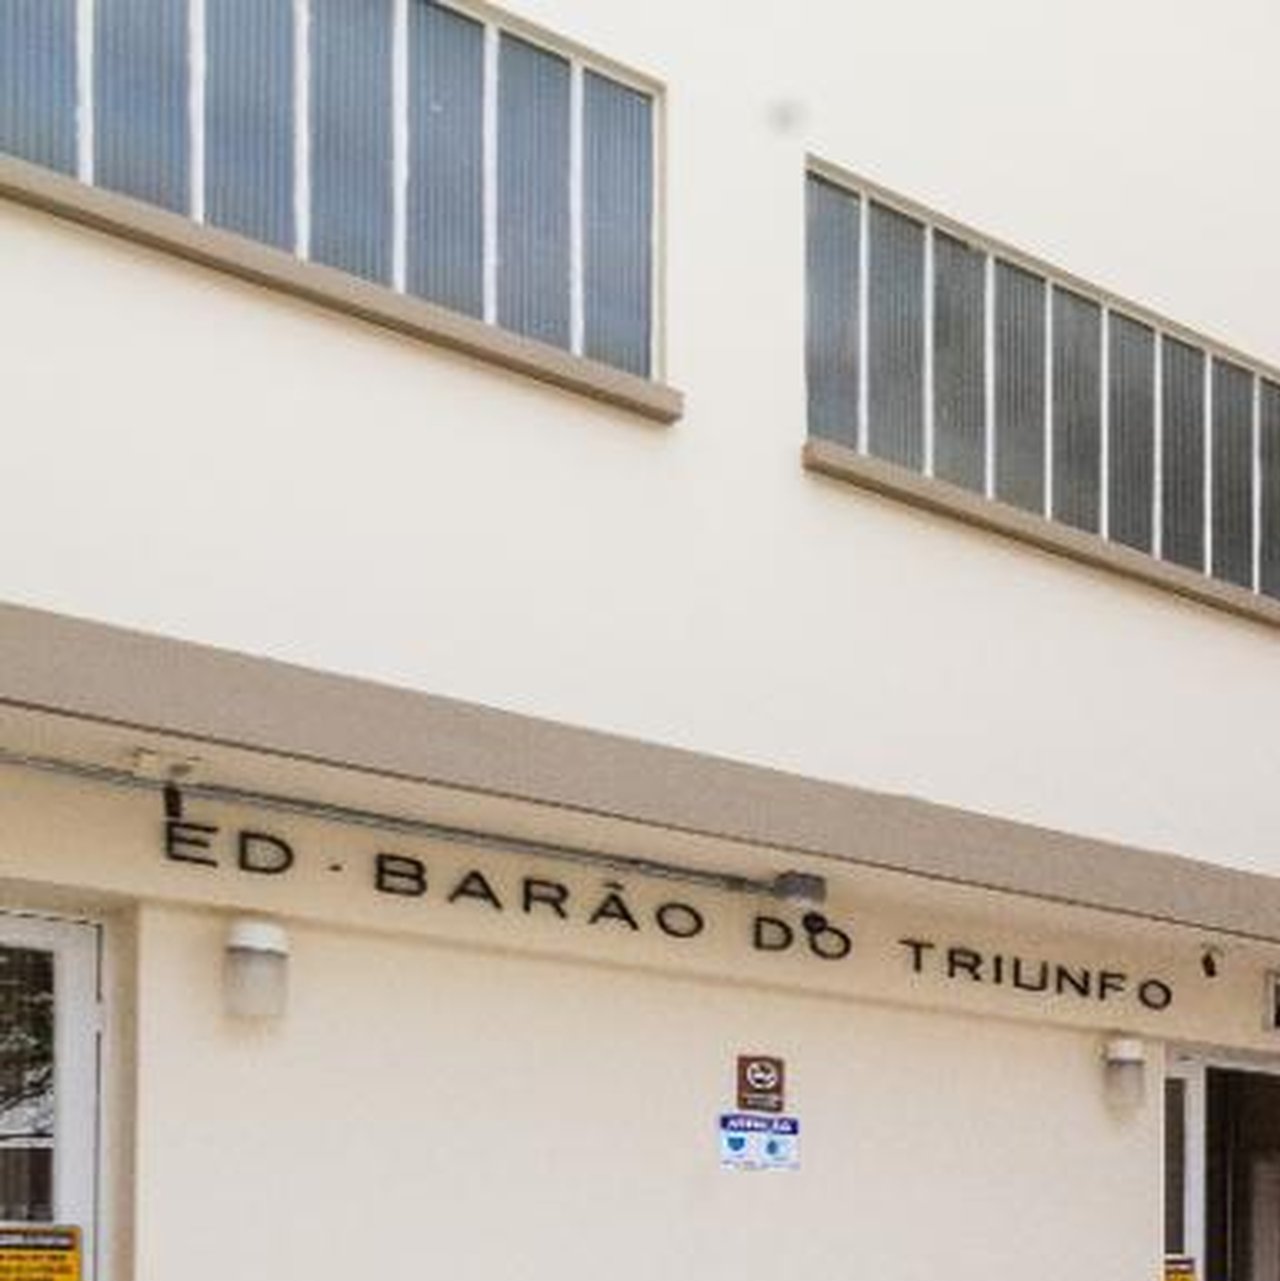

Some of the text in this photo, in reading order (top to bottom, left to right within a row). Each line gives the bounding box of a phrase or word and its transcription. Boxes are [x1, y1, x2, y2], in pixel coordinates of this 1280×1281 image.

[374, 852, 704, 938] BARÃO
[753, 915, 852, 960] DO
[899, 938, 1173, 1011] TRIUNFO
